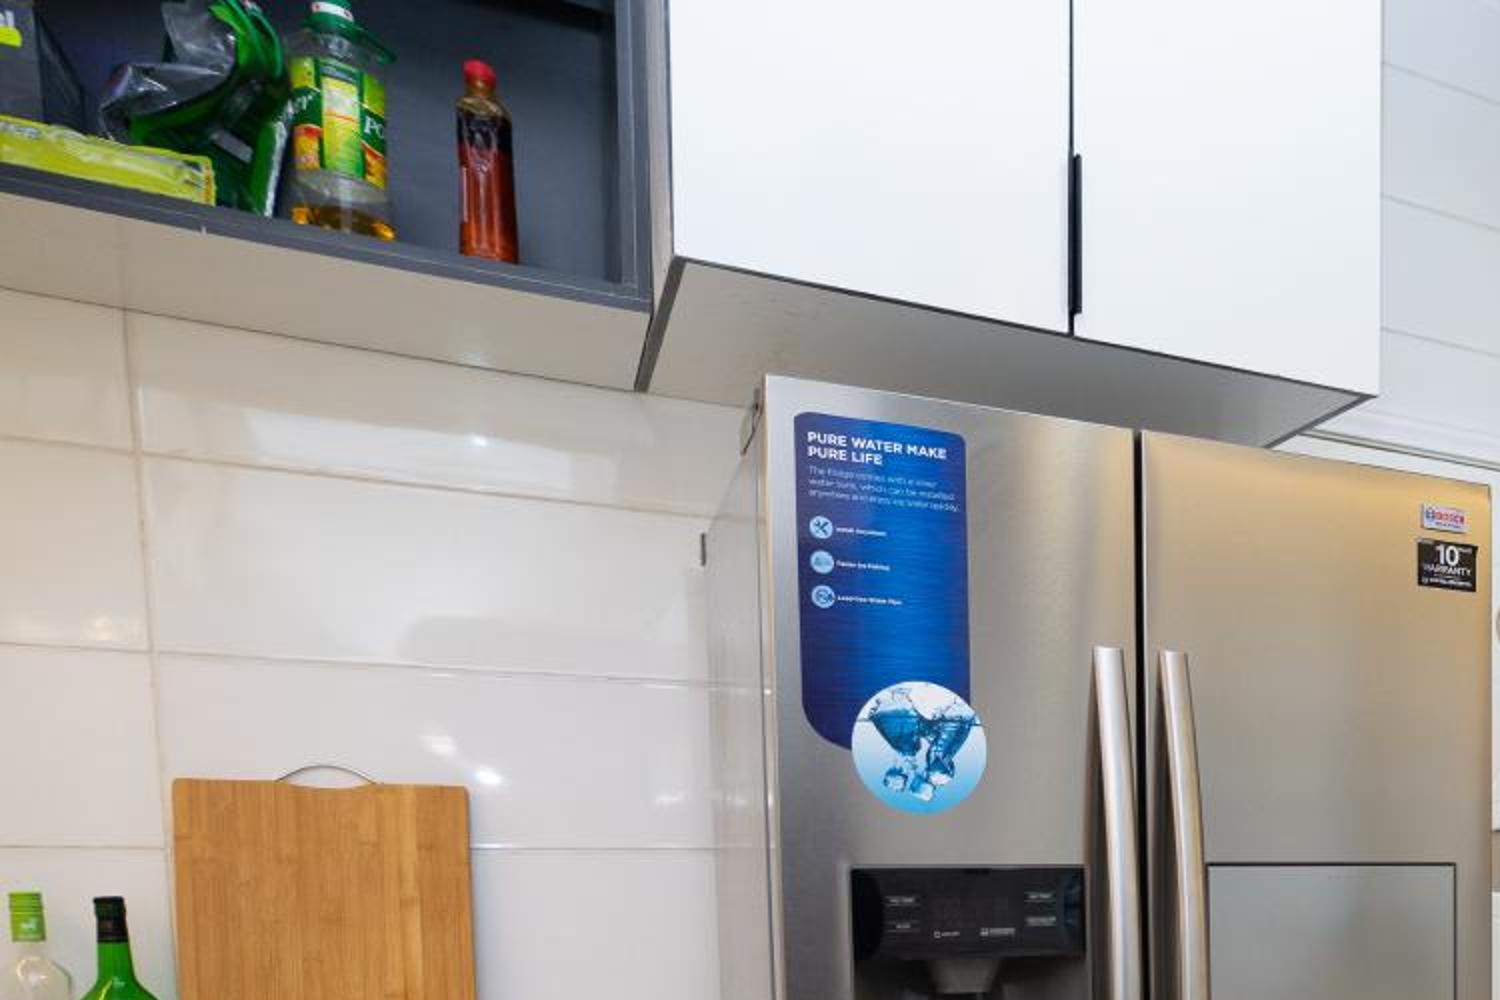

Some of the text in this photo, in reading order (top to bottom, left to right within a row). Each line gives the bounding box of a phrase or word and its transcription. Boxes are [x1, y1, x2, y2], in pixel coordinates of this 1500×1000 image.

[807, 431, 947, 460] PURE WATER MAKE
[807, 446, 883, 465] PURE LIFE
[1435, 544, 1459, 566] 10
